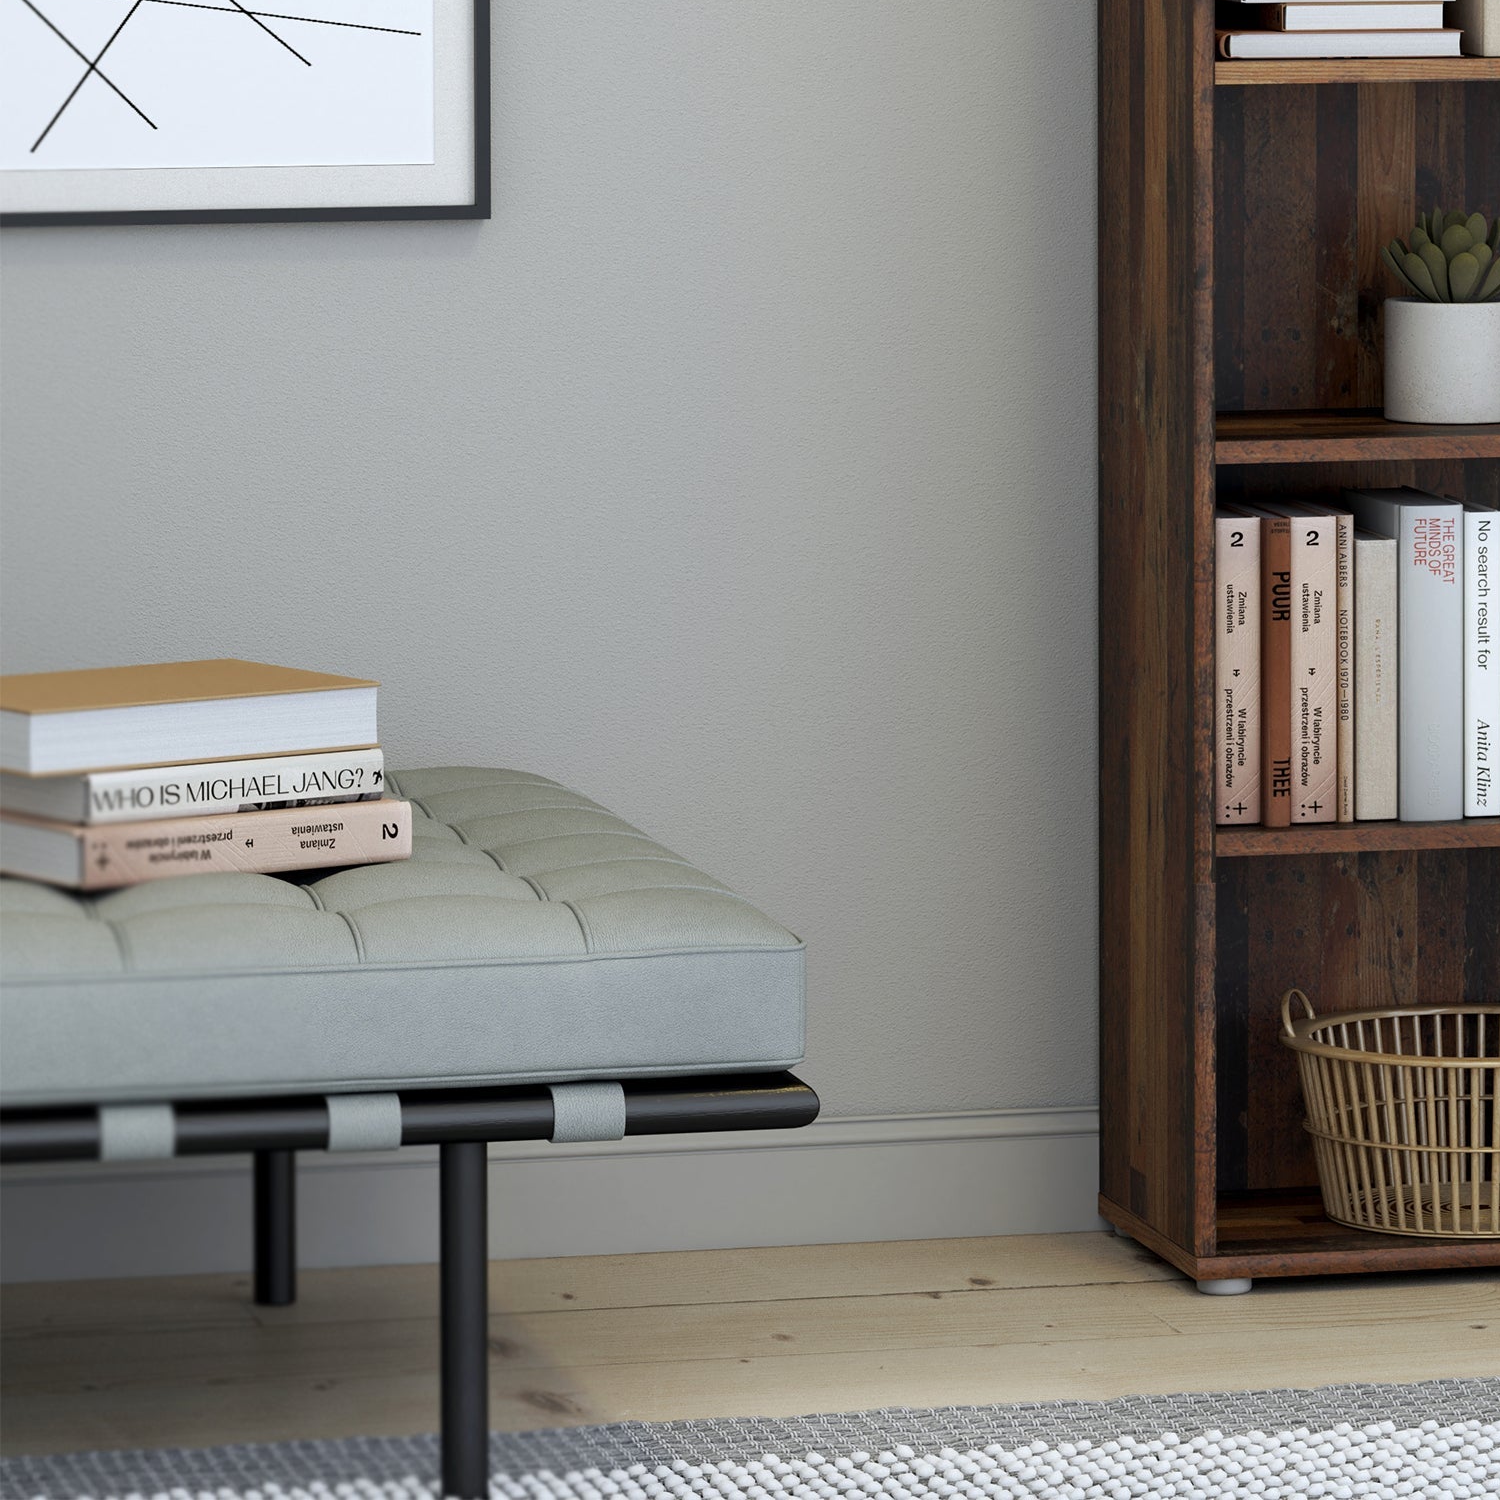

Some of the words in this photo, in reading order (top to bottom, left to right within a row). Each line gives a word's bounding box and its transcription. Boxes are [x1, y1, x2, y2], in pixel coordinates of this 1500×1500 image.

[1230, 531, 1244, 547] 2
[1306, 530, 1320, 546] 2
[1339, 524, 1347, 550] ANNI
[1413, 518, 1427, 566] FUTURE
[1428, 518, 1441, 557] MINDS
[1442, 518, 1455, 541] THE
[1478, 520, 1491, 542] No
[1339, 553, 1348, 588] ALBERS
[1428, 559, 1441, 576] OF
[1442, 546, 1455, 584] GREAT
[1477, 546, 1490, 597] search
[1226, 584, 1235, 634] ustawienia
[1238, 591, 1247, 625] Zmiana
[1271, 571, 1290, 621] PUUR
[1302, 582, 1311, 632] ustawienia
[1313, 590, 1322, 624] Zmiana
[1340, 609, 1348, 664] NOTEBOOK
[1477, 602, 1490, 644] result
[1477, 649, 1490, 670] for
[1224, 688, 1235, 740] przestrzeni
[1238, 708, 1247, 719] W
[1300, 687, 1310, 739] przestrzeni
[1313, 707, 1322, 717] W
[1236, 720, 1247, 766] labiryncie
[1311, 719, 1322, 765] labiryncie
[1477, 719, 1491, 761] Anita
[1225, 747, 1236, 788] obrazów
[1273, 756, 1291, 797] THEE
[1300, 746, 1311, 787] obrazów
[93, 785, 154, 812] WHO
[160, 784, 181, 806] IS
[186, 774, 289, 802] MICHAEL
[292, 768, 364, 793] JANG?
[1476, 766, 1491, 807] Klinz
[177, 829, 233, 845] przestrzeni
[291, 822, 344, 835] ustawienia
[299, 838, 336, 849] Zmiana
[381, 822, 399, 840] 2
